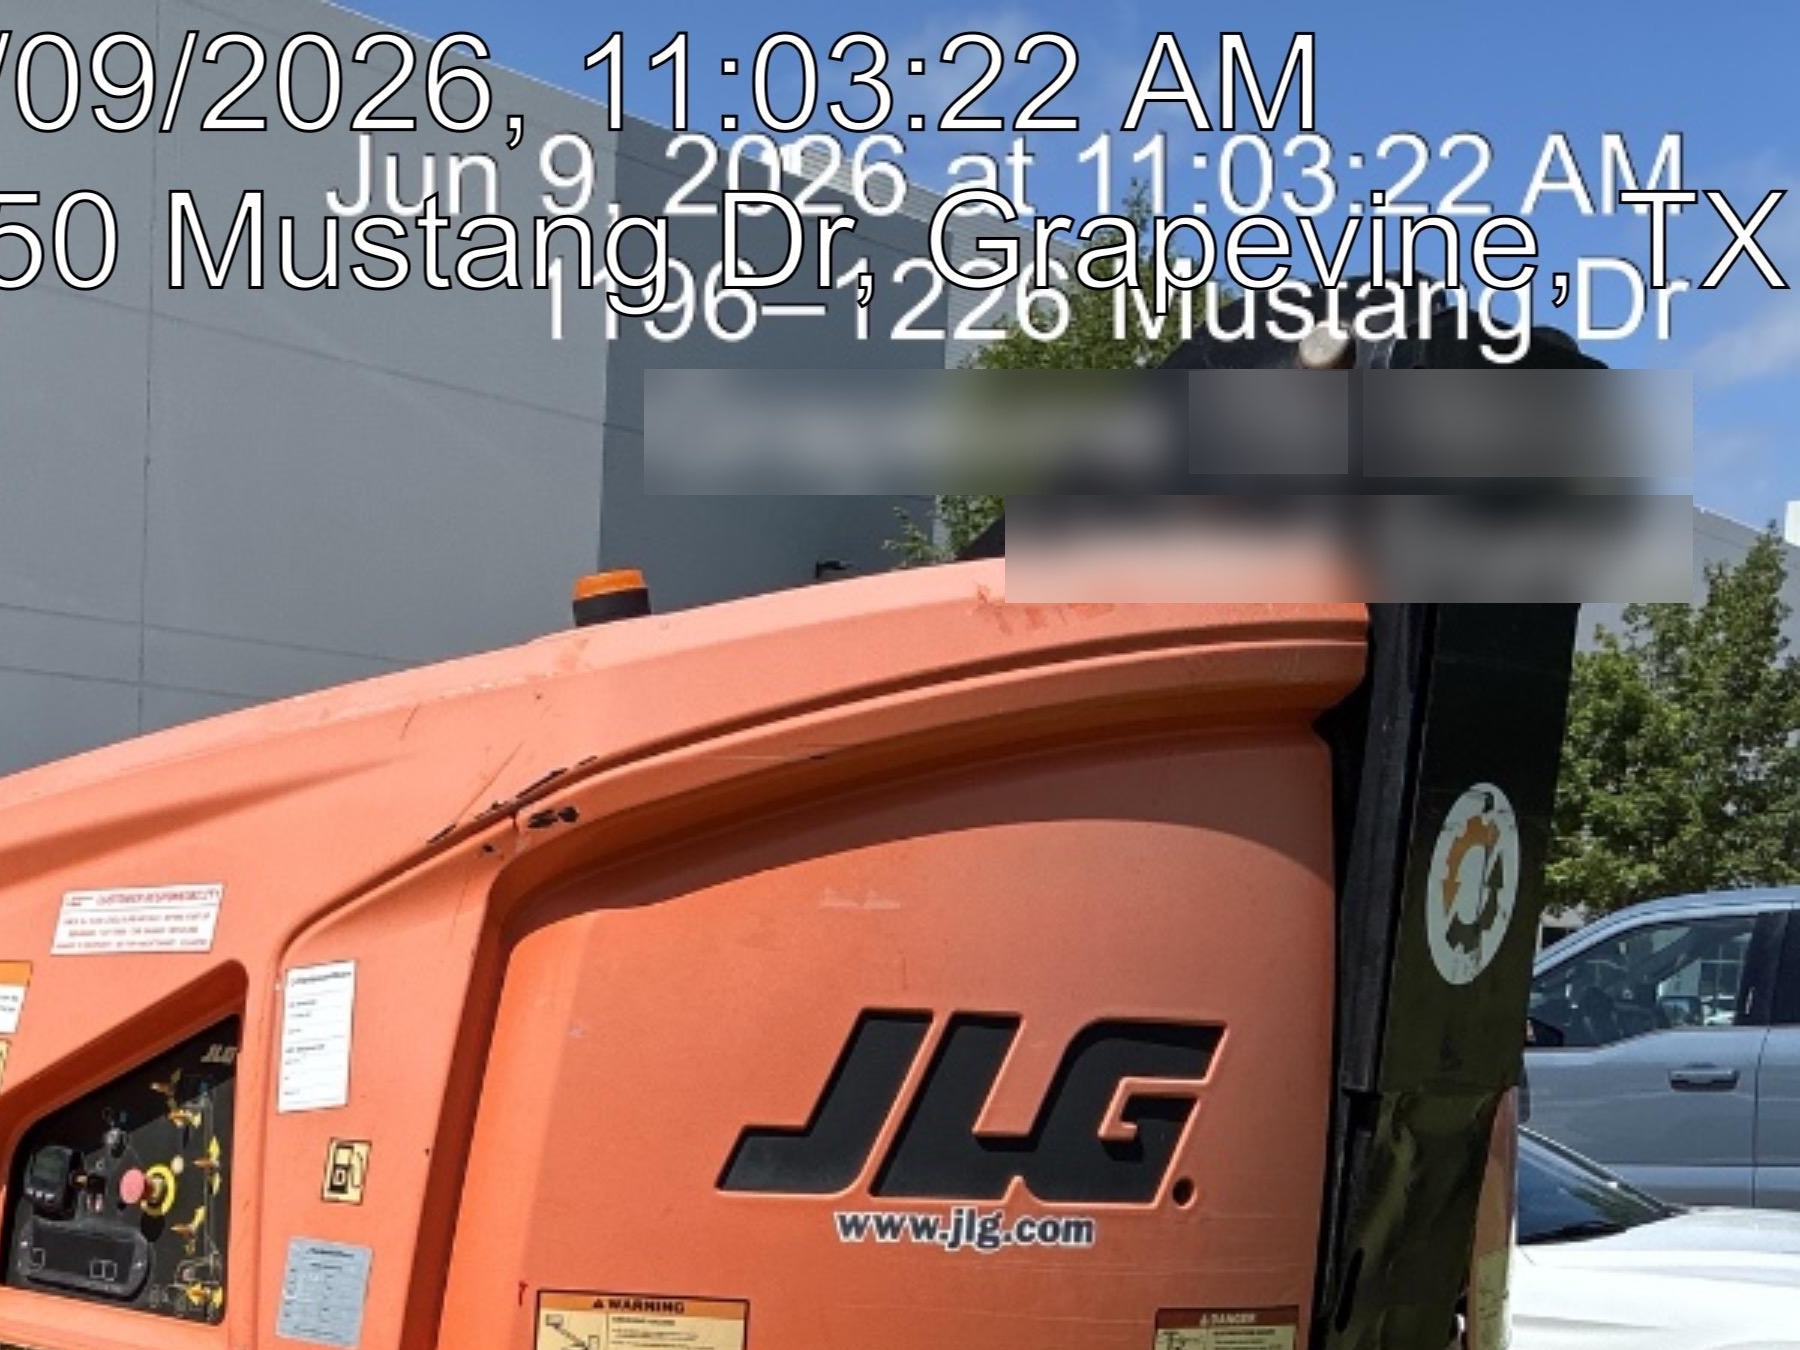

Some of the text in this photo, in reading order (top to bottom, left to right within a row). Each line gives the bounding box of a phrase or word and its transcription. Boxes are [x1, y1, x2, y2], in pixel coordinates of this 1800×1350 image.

[716, 1008, 1228, 1210] JLG
[832, 1205, 1095, 1251] www.jlg.com
[607, 1298, 686, 1315] WARNING
[1210, 1312, 1259, 1325] DANGER
